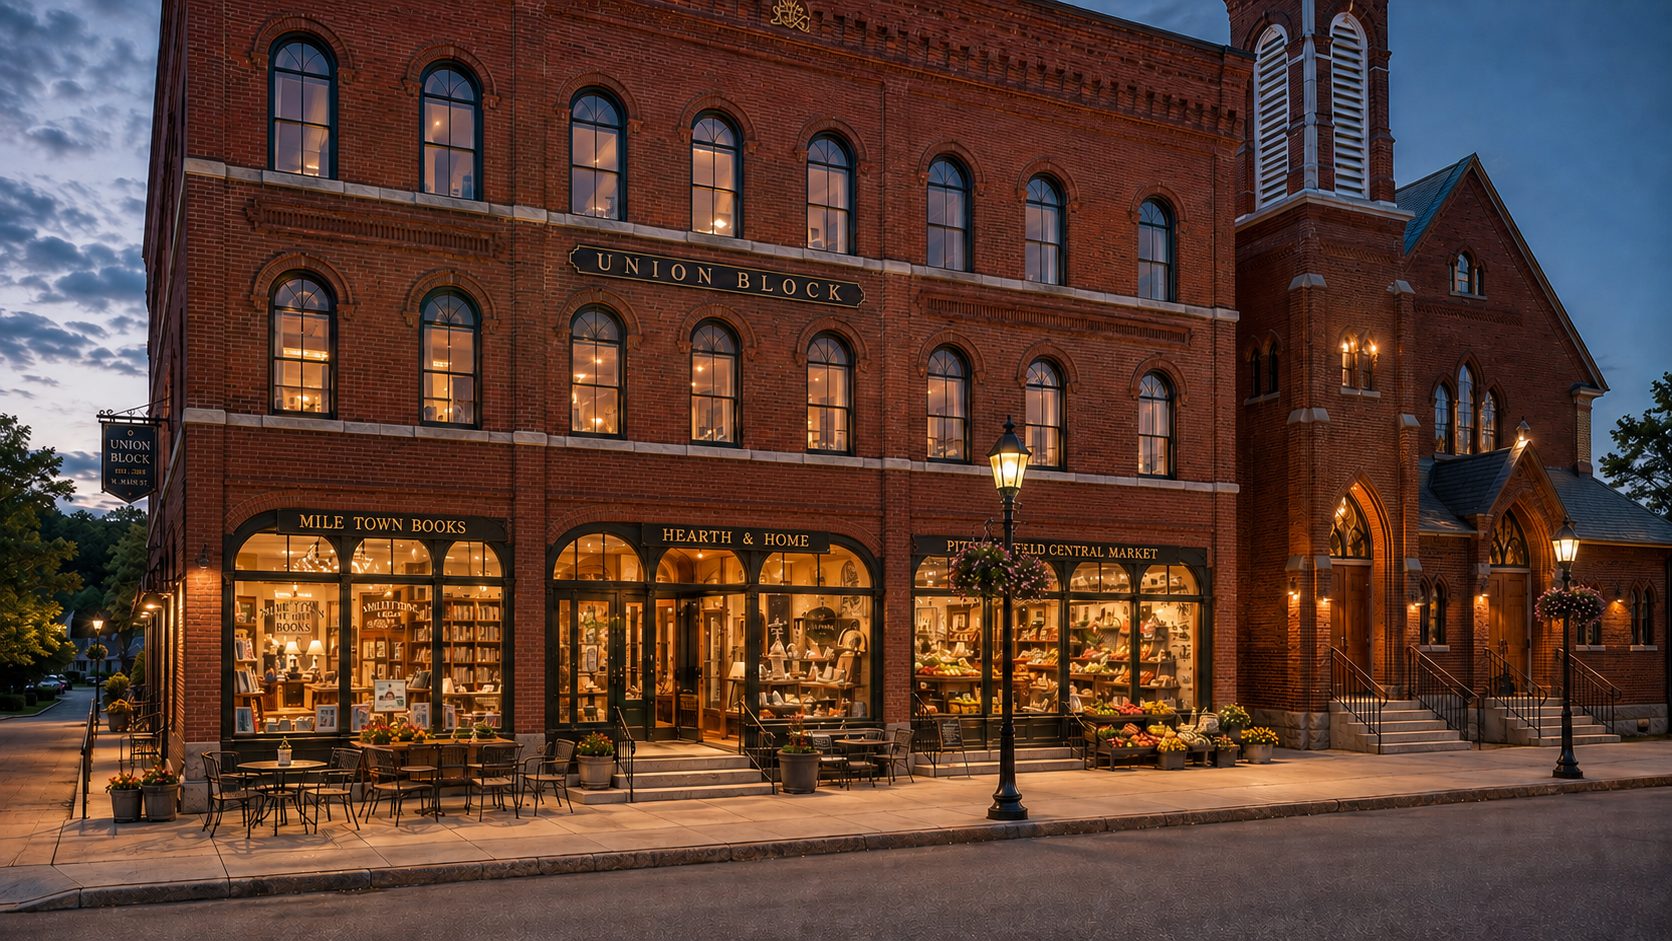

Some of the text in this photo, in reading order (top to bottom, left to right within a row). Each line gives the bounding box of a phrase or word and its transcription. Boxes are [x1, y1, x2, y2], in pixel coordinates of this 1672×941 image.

[597, 253, 843, 301] UNION BLOCK
[110, 439, 151, 451] UNION
[110, 452, 151, 465] BLOCK
[299, 514, 467, 534] MILE TOWN BOOKS
[662, 528, 810, 547] HEARTH & HOME
[1049, 544, 1105, 558] CENTRAL
[1108, 546, 1159, 560] MARKET
